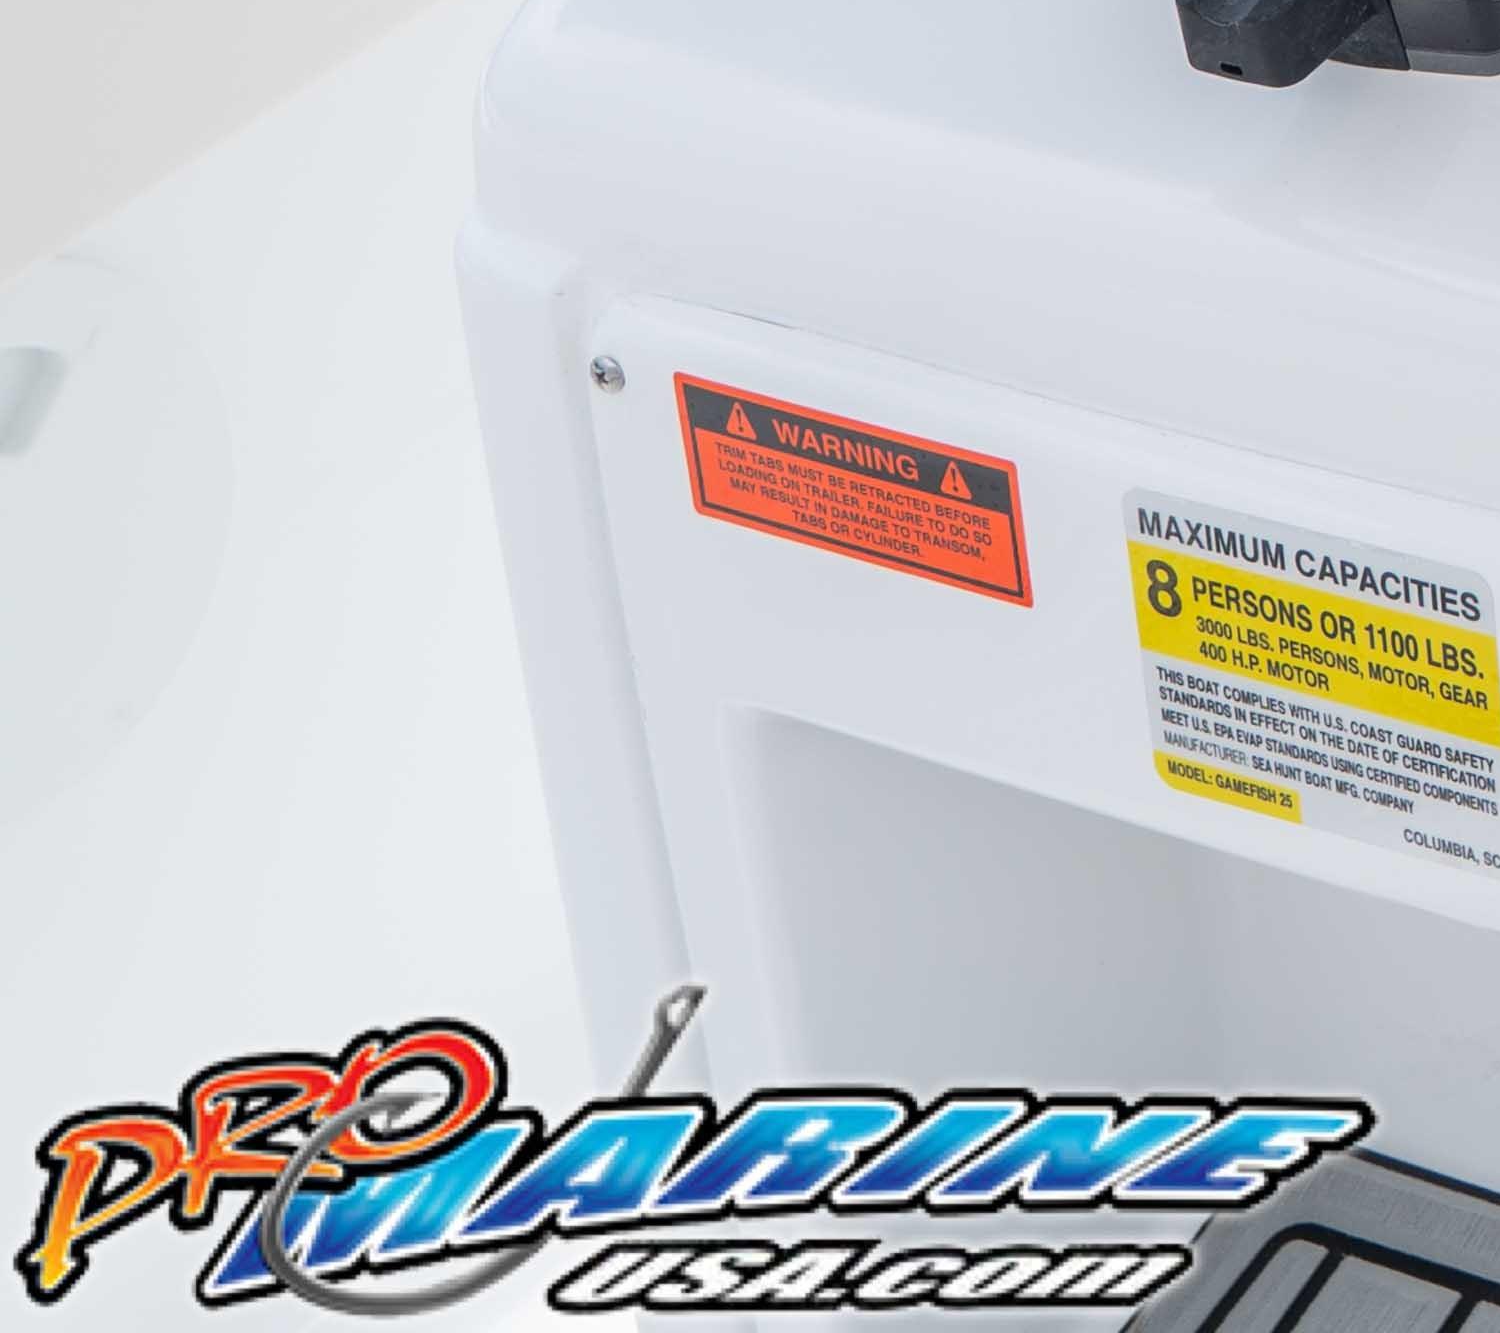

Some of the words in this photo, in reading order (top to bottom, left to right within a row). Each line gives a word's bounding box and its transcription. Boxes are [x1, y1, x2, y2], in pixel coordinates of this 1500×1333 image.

[771, 418, 920, 482] WARNING
[714, 441, 747, 460] TRIM
[749, 450, 785, 470] TABS
[788, 460, 825, 483] MUST
[828, 471, 847, 489] BE
[849, 477, 931, 513] RETRACTED
[934, 501, 991, 530] BEFORE
[1137, 506, 1286, 572] MAXIMUM
[1295, 549, 1482, 622] CAPACITIES
[1147, 559, 1182, 618] 8
[1192, 576, 1313, 632] PERSONS
[1320, 611, 1357, 645] OR
[1365, 623, 1419, 663] 1100
[1426, 638, 1485, 680] LBS.
[1196, 615, 1233, 641] 3000
[1237, 625, 1275, 653] LBS.
[1279, 637, 1364, 680] PERSONS,
[1368, 659, 1434, 694] MOTOR,
[1439, 680, 1488, 710] GEAR
[1199, 640, 1228, 663] 400
[1231, 648, 1262, 674] H.P.
[1267, 656, 1329, 691] MOTOR
[1167, 759, 1213, 786] MODEL:
[1215, 773, 1277, 805] GAMEFISH
[1279, 793, 1293, 809] 25
[1403, 827, 1480, 866] COLUMBIA,
